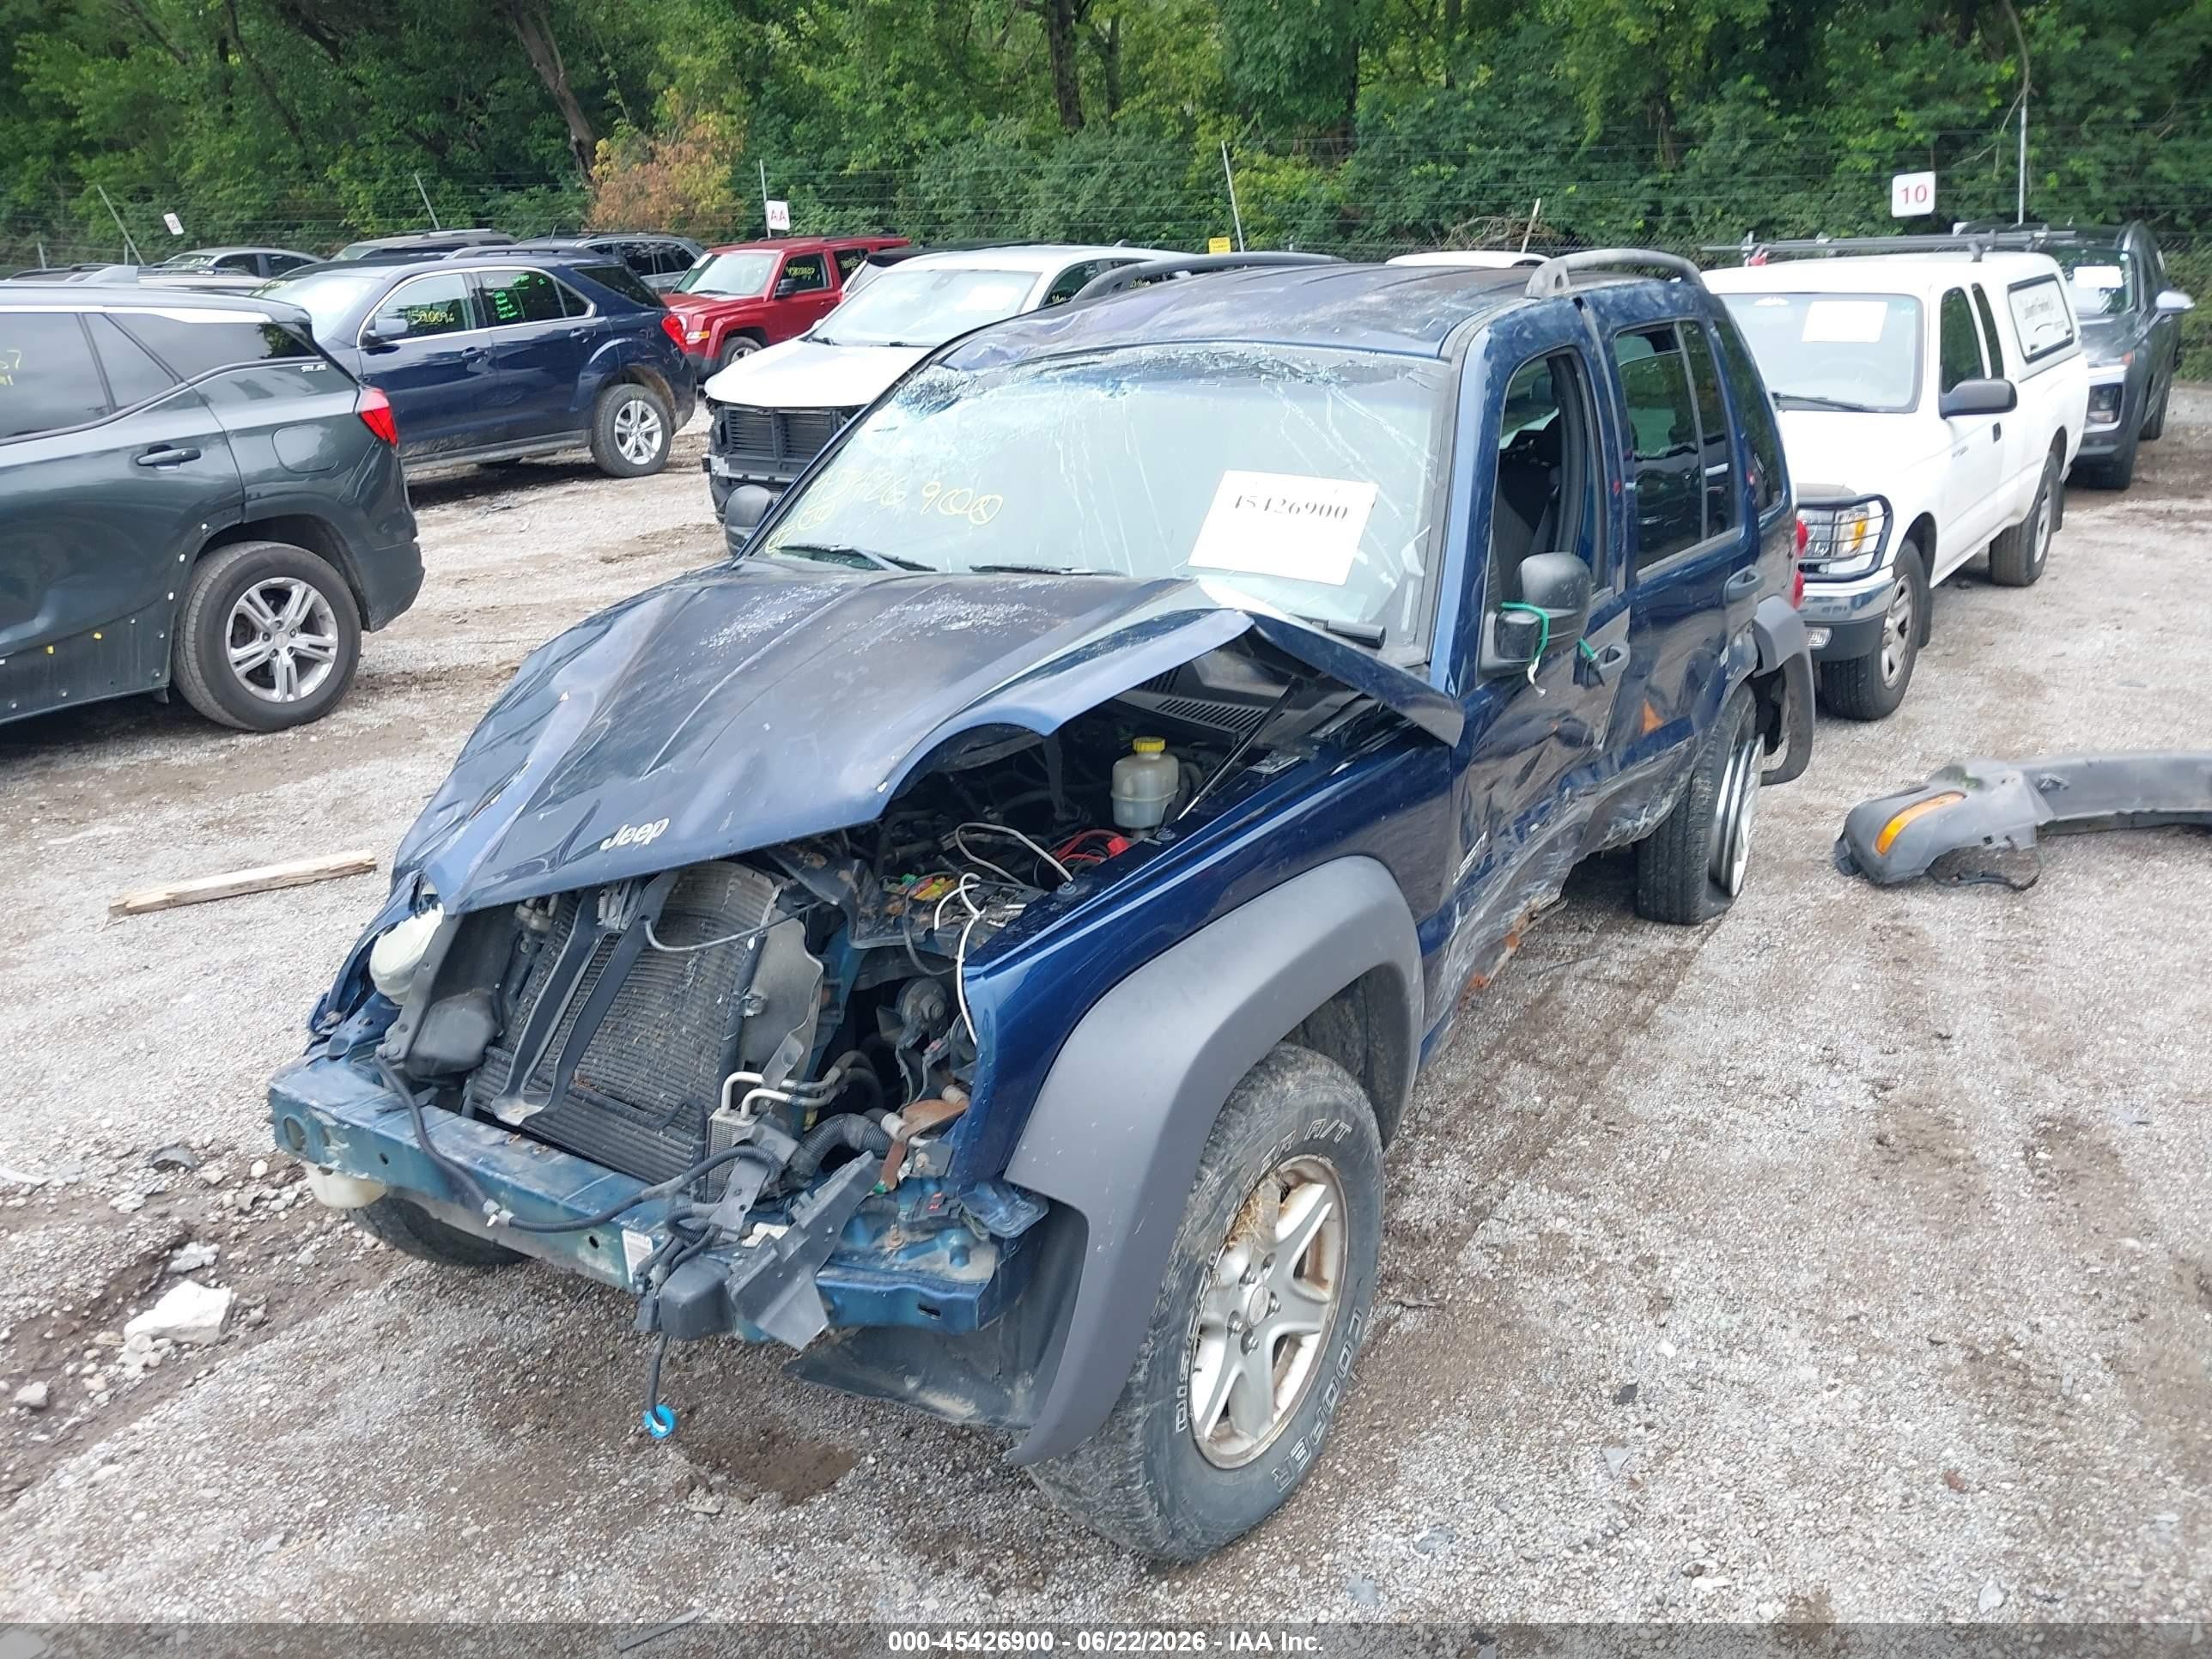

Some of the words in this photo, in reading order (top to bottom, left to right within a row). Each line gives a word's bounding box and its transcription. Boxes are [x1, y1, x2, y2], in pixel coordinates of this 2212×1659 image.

[1900, 184, 1928, 205] 10
[599, 817, 670, 851] Jeep
[1271, 1306, 1363, 1492] COOPER
